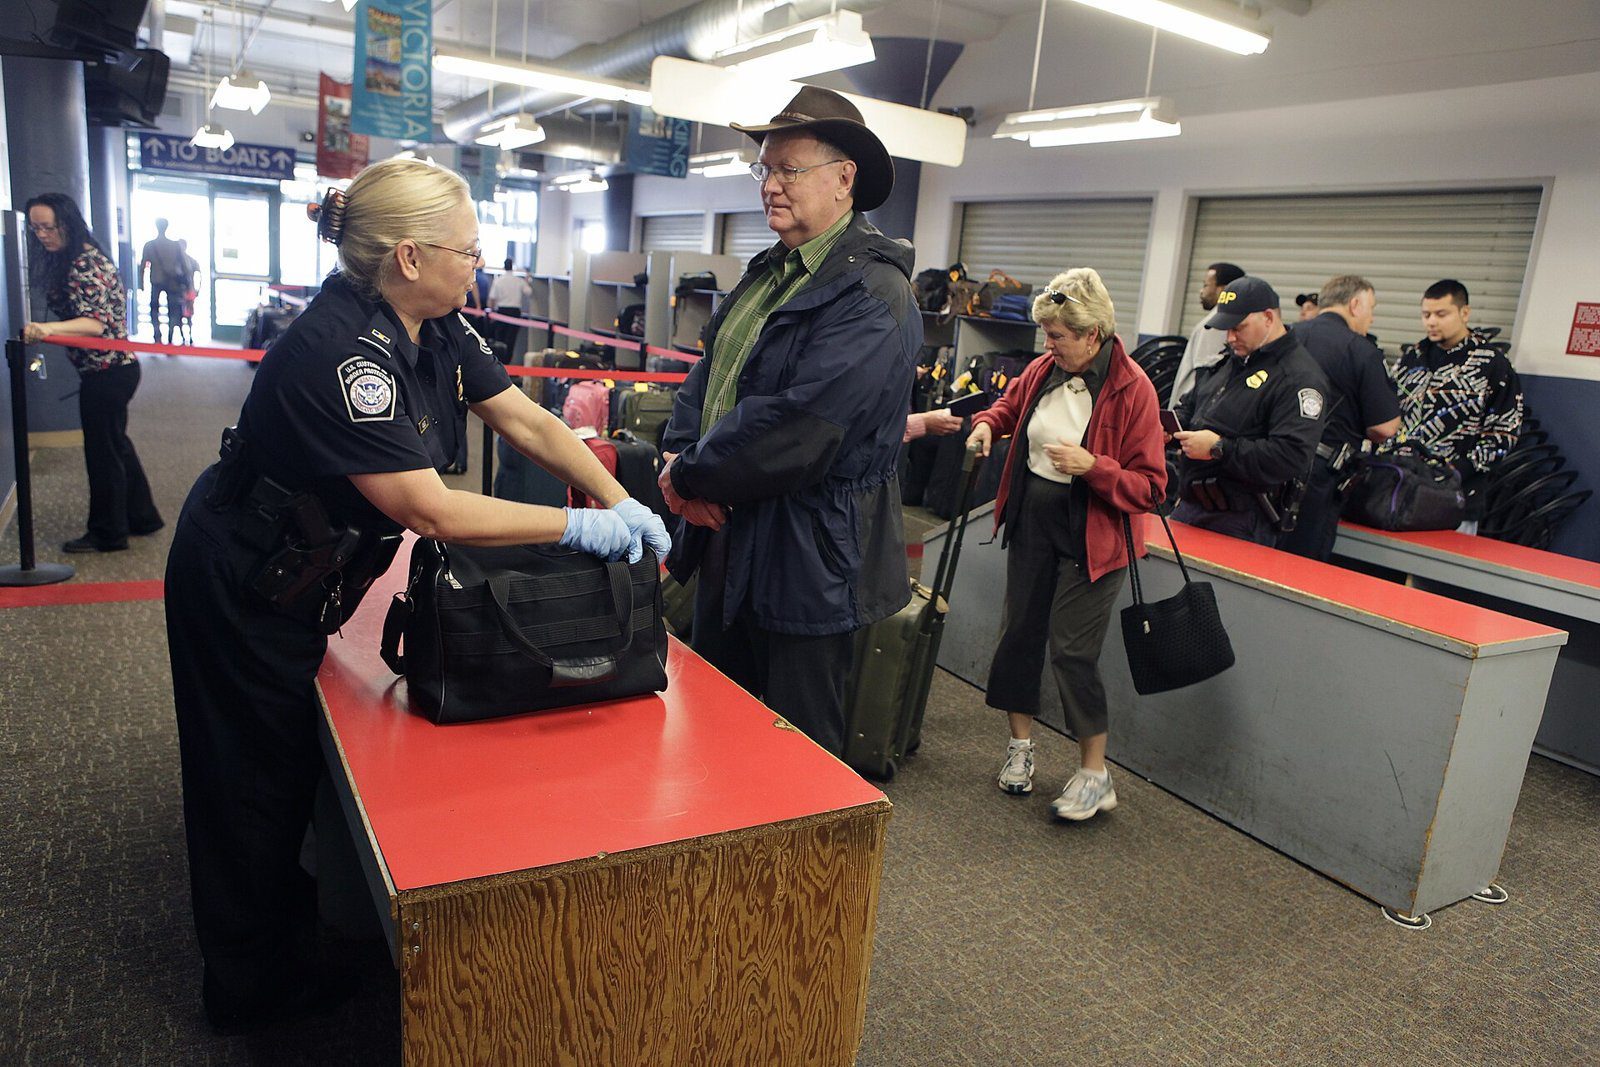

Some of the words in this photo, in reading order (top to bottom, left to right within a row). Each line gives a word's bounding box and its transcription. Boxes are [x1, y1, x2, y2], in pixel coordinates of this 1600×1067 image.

[402, 0, 428, 138] VICTORIA
[167, 138, 198, 161] TO
[205, 147, 271, 169] BOATS
[669, 119, 690, 177] KIING
[1217, 290, 1237, 304] BP
[345, 368, 364, 385] BORDER
